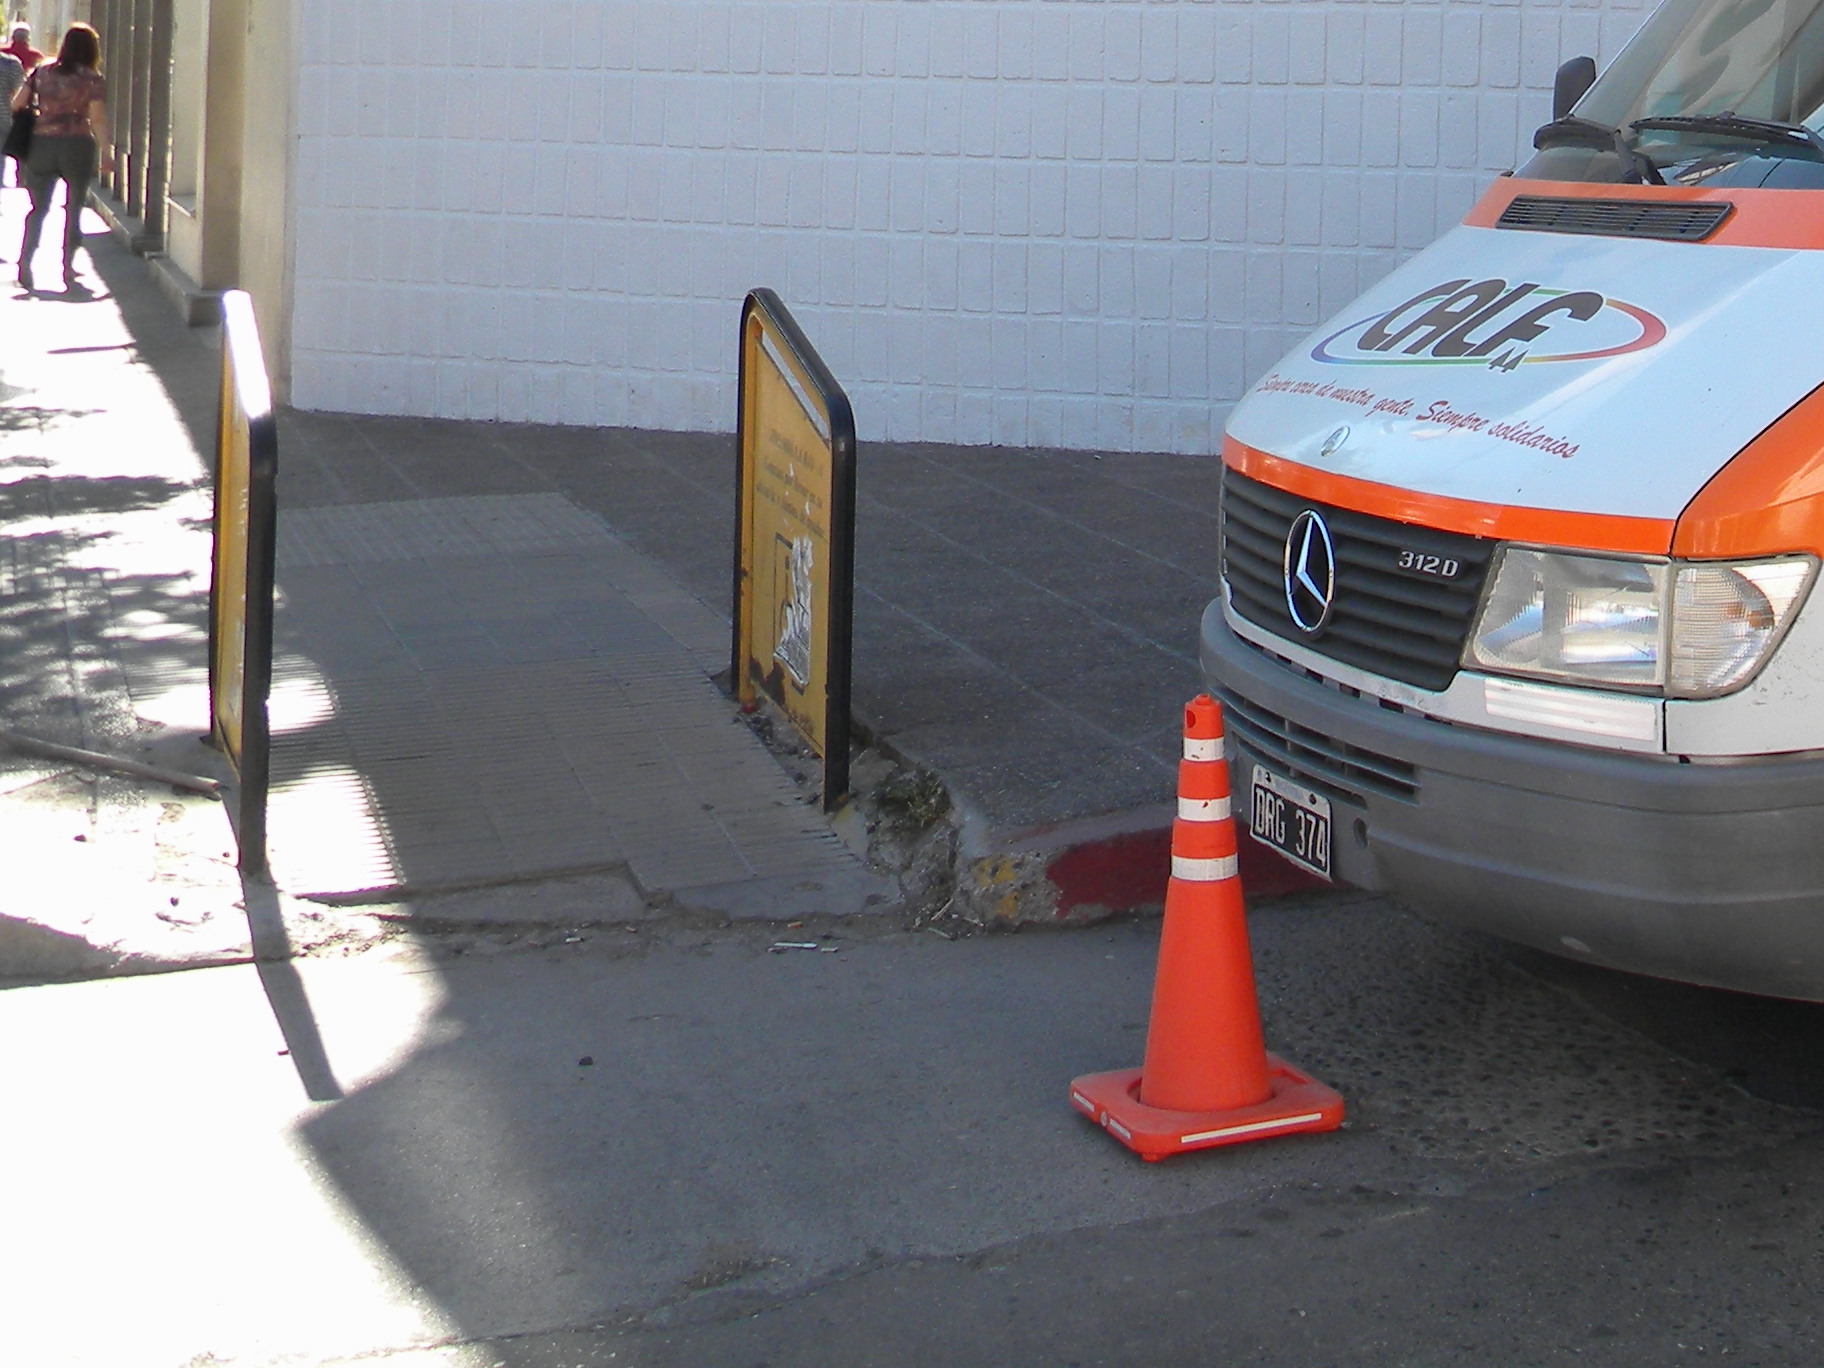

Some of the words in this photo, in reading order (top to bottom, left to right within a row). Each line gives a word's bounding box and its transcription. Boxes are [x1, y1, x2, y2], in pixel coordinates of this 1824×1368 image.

[1357, 278, 1603, 358] CALF
[1416, 400, 1490, 432] Siempre
[1487, 419, 1582, 459] solidarios
[1296, 809, 1326, 867] 374
